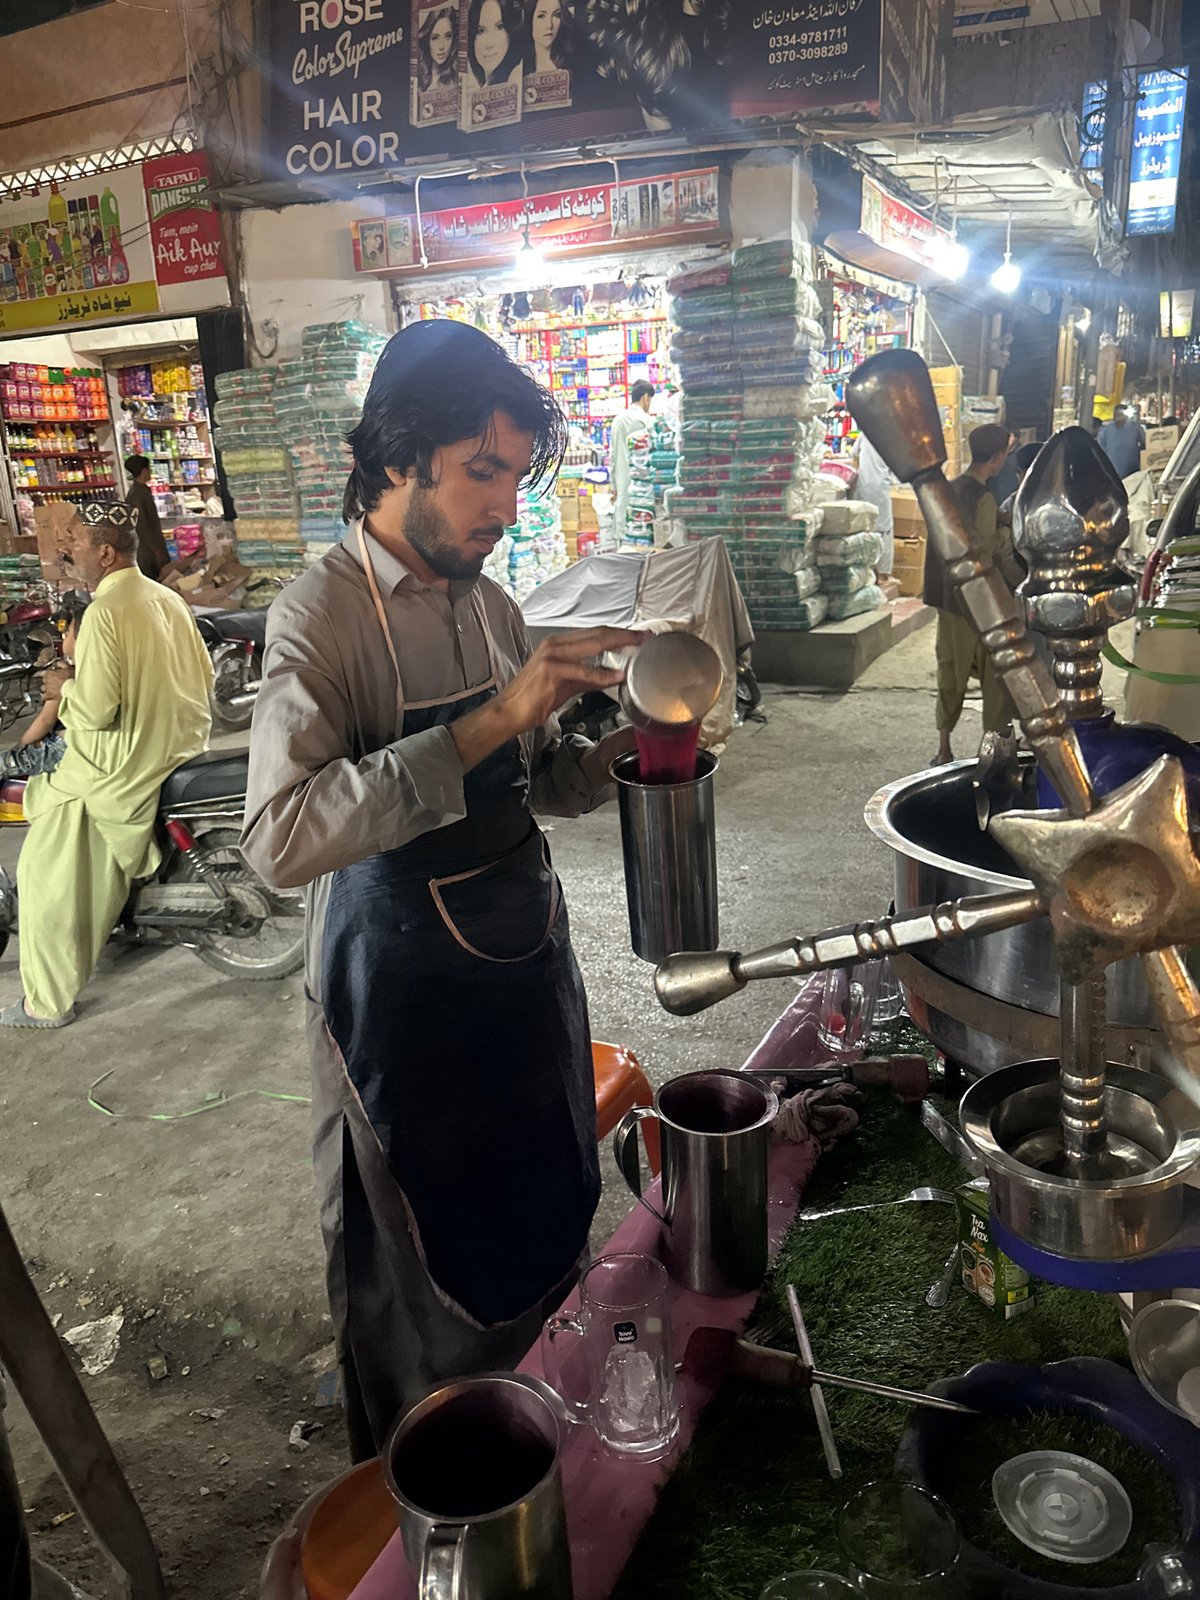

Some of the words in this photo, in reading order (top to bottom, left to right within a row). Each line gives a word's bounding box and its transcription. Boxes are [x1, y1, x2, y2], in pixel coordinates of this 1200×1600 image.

[300, 0, 384, 34] ROSE
[752, 9, 773, 29] خان
[769, 25, 847, 49] 0334-9781711
[768, 42, 848, 65] 0370-3098289
[1140, 73, 1153, 87] Al
[303, 90, 382, 131] HAIR
[286, 131, 400, 175] COLOR
[157, 171, 197, 188] TAPAL
[572, 190, 606, 220] کوئٹہ
[179, 222, 198, 235] mein
[157, 238, 187, 267] Aik
[189, 237, 221, 262] Aur
[184, 263, 199, 275] cup
[200, 258, 217, 272] chai
[93, 293, 112, 312] شاہ
[113, 291, 132, 312] نیو
[970, 1213, 986, 1230] Tea
